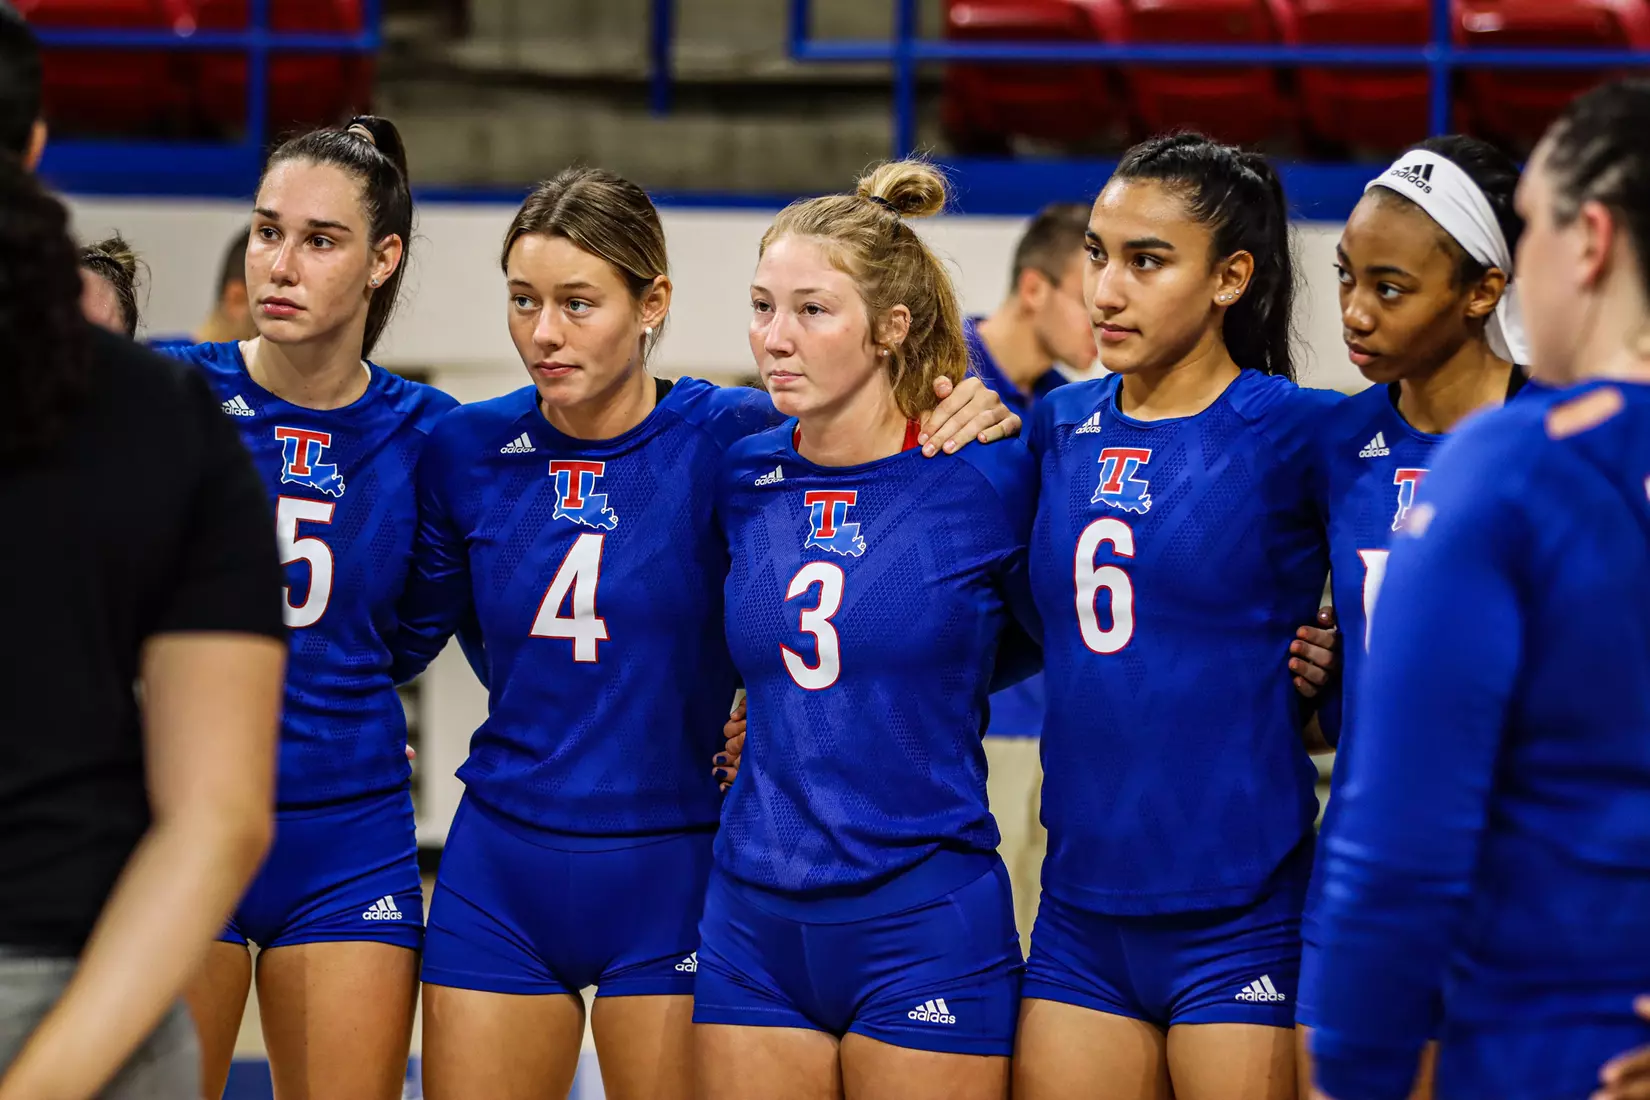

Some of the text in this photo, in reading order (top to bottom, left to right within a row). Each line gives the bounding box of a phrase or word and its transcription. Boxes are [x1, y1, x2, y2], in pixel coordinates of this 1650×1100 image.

[1390, 169, 1432, 194] adidas
[275, 494, 336, 629] 5
[528, 532, 610, 663] 4
[1073, 516, 1135, 655] 6
[779, 561, 845, 690] 3
[362, 910, 402, 920] adidas
[907, 1010, 956, 1024] adidas
[1234, 992, 1285, 1001] adidas
